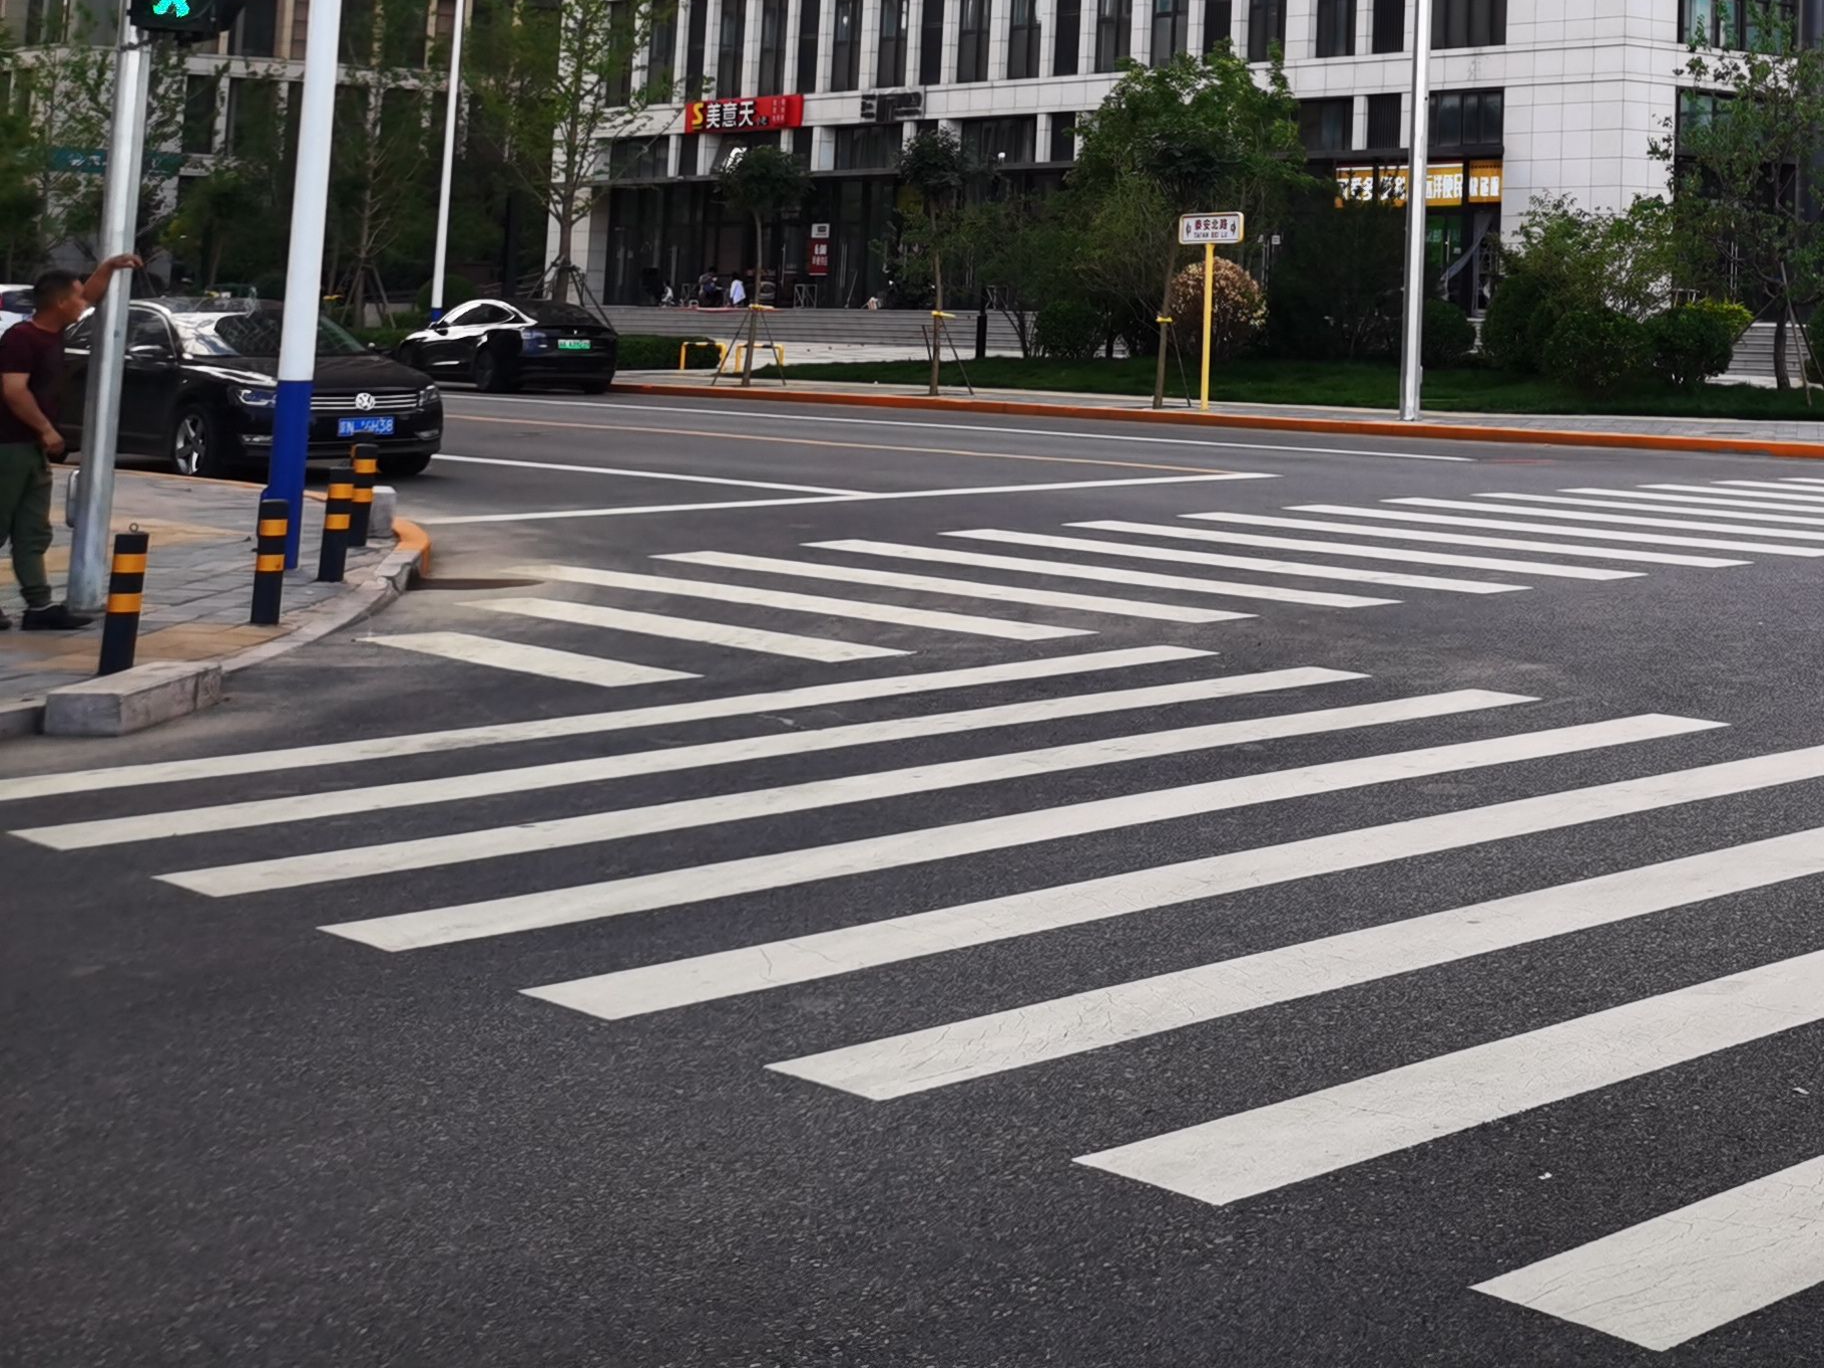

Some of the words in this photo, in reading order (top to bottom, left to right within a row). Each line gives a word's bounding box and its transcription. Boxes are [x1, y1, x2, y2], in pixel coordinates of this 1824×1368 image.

[706, 100, 754, 129] 美意天
[1195, 218, 1228, 230] 泰安北路
